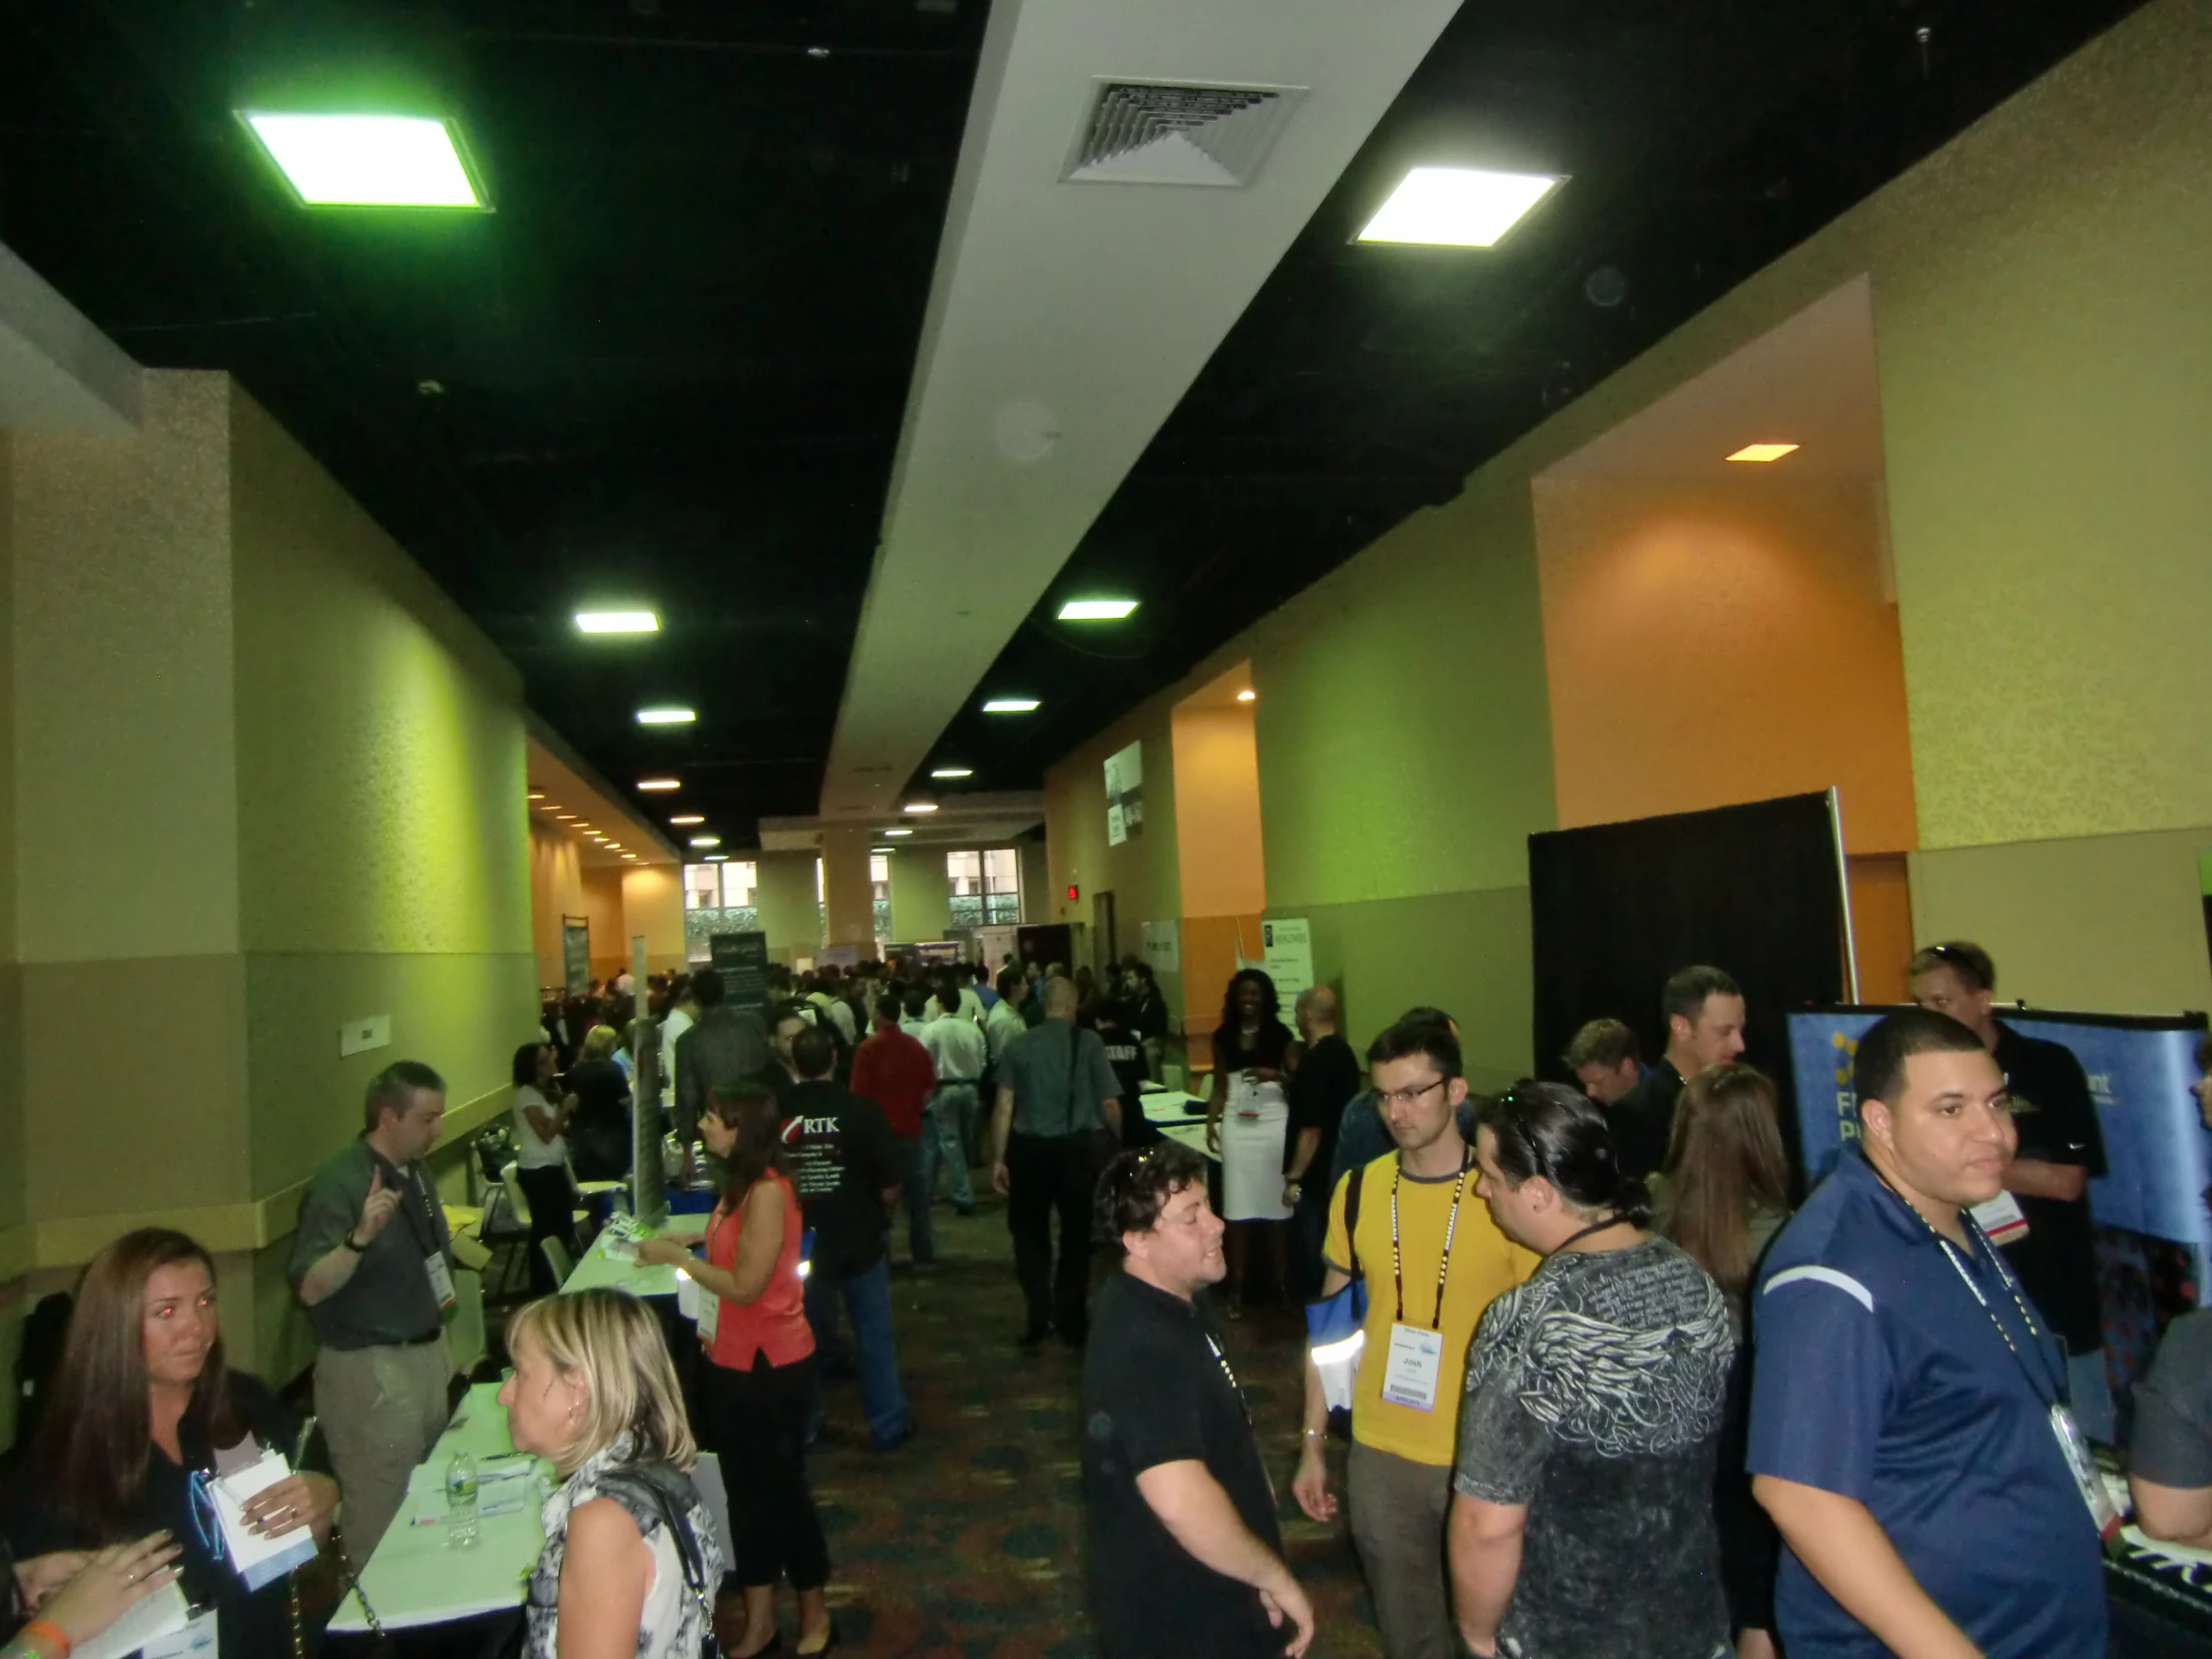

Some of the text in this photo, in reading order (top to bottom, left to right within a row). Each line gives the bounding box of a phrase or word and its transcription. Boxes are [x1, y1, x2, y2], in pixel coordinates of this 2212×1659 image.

[804, 1117, 839, 1133] RTK
[1444, 1203, 1458, 1251] SHAREASALE
[1403, 1358, 1422, 1369] Josh
